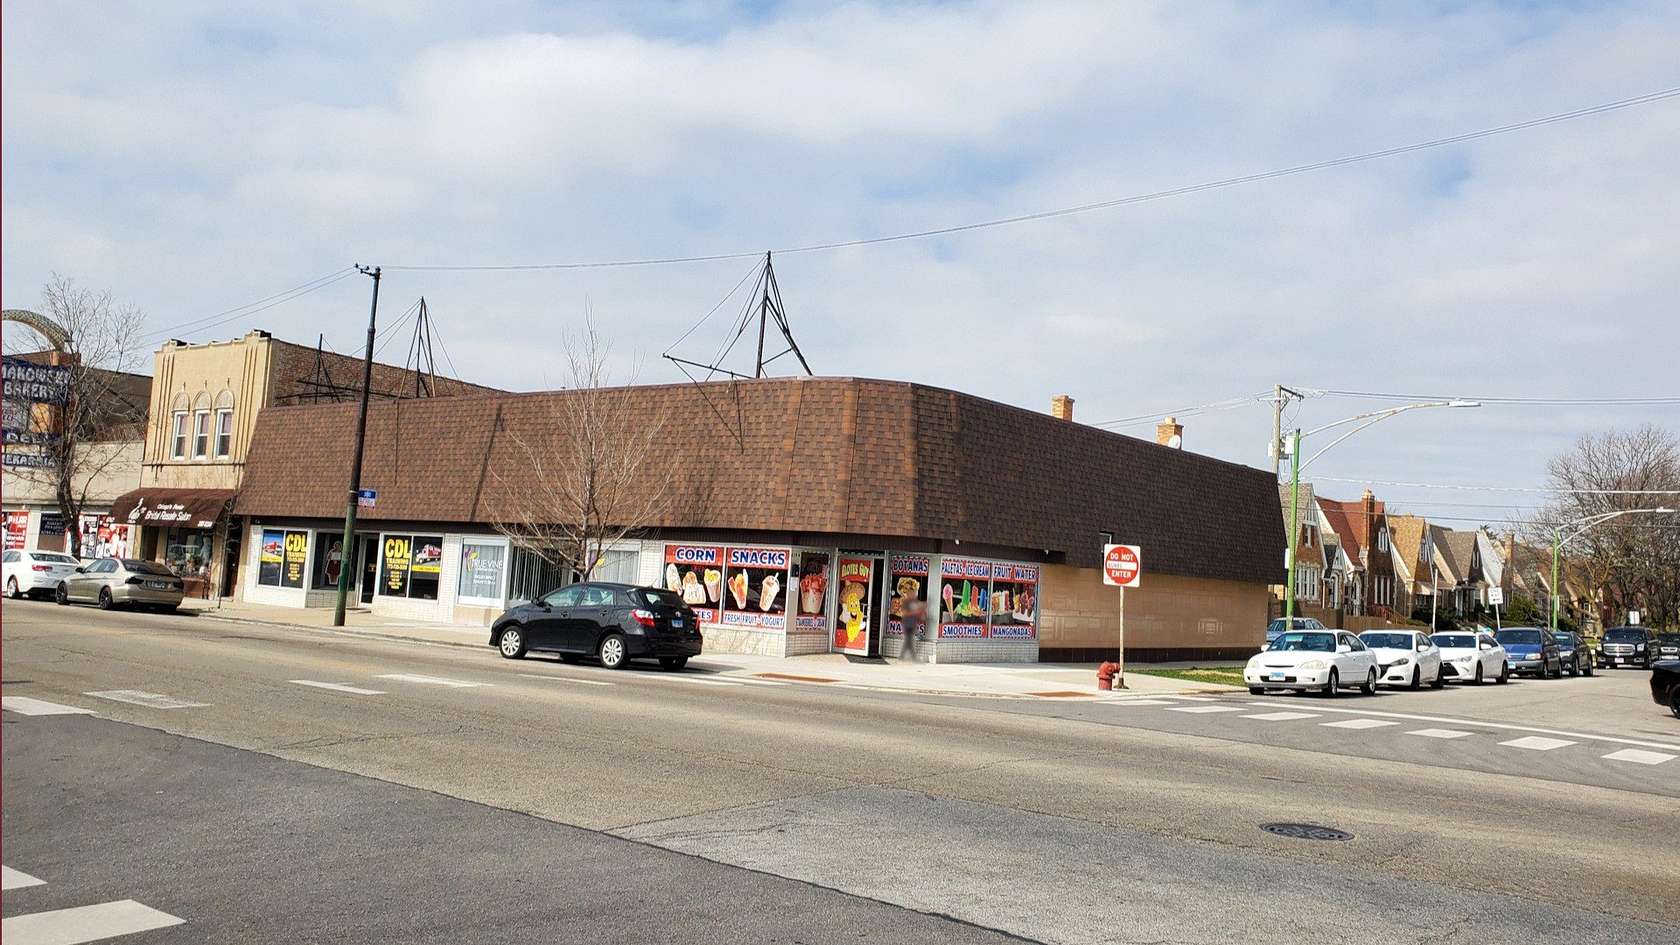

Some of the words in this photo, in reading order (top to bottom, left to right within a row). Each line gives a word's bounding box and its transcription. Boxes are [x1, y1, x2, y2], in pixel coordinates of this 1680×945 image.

[286, 533, 307, 552] CDL
[385, 538, 411, 558] CDL
[676, 548, 715, 562] CORN
[732, 551, 785, 565] SNACKS
[1110, 552, 1119, 560] DO
[1121, 553, 1133, 561] NOT
[893, 560, 928, 572] BOTANAS
[973, 564, 990, 576] CREAM
[994, 566, 1011, 577] FRUIT
[1014, 568, 1036, 579] WATER
[724, 613, 740, 622] FRESH
[742, 614, 757, 624] FRUIT
[761, 616, 784, 626] YOGURT
[943, 626, 982, 635] SMOOTHIES
[992, 626, 1032, 637] MANGONADAS
